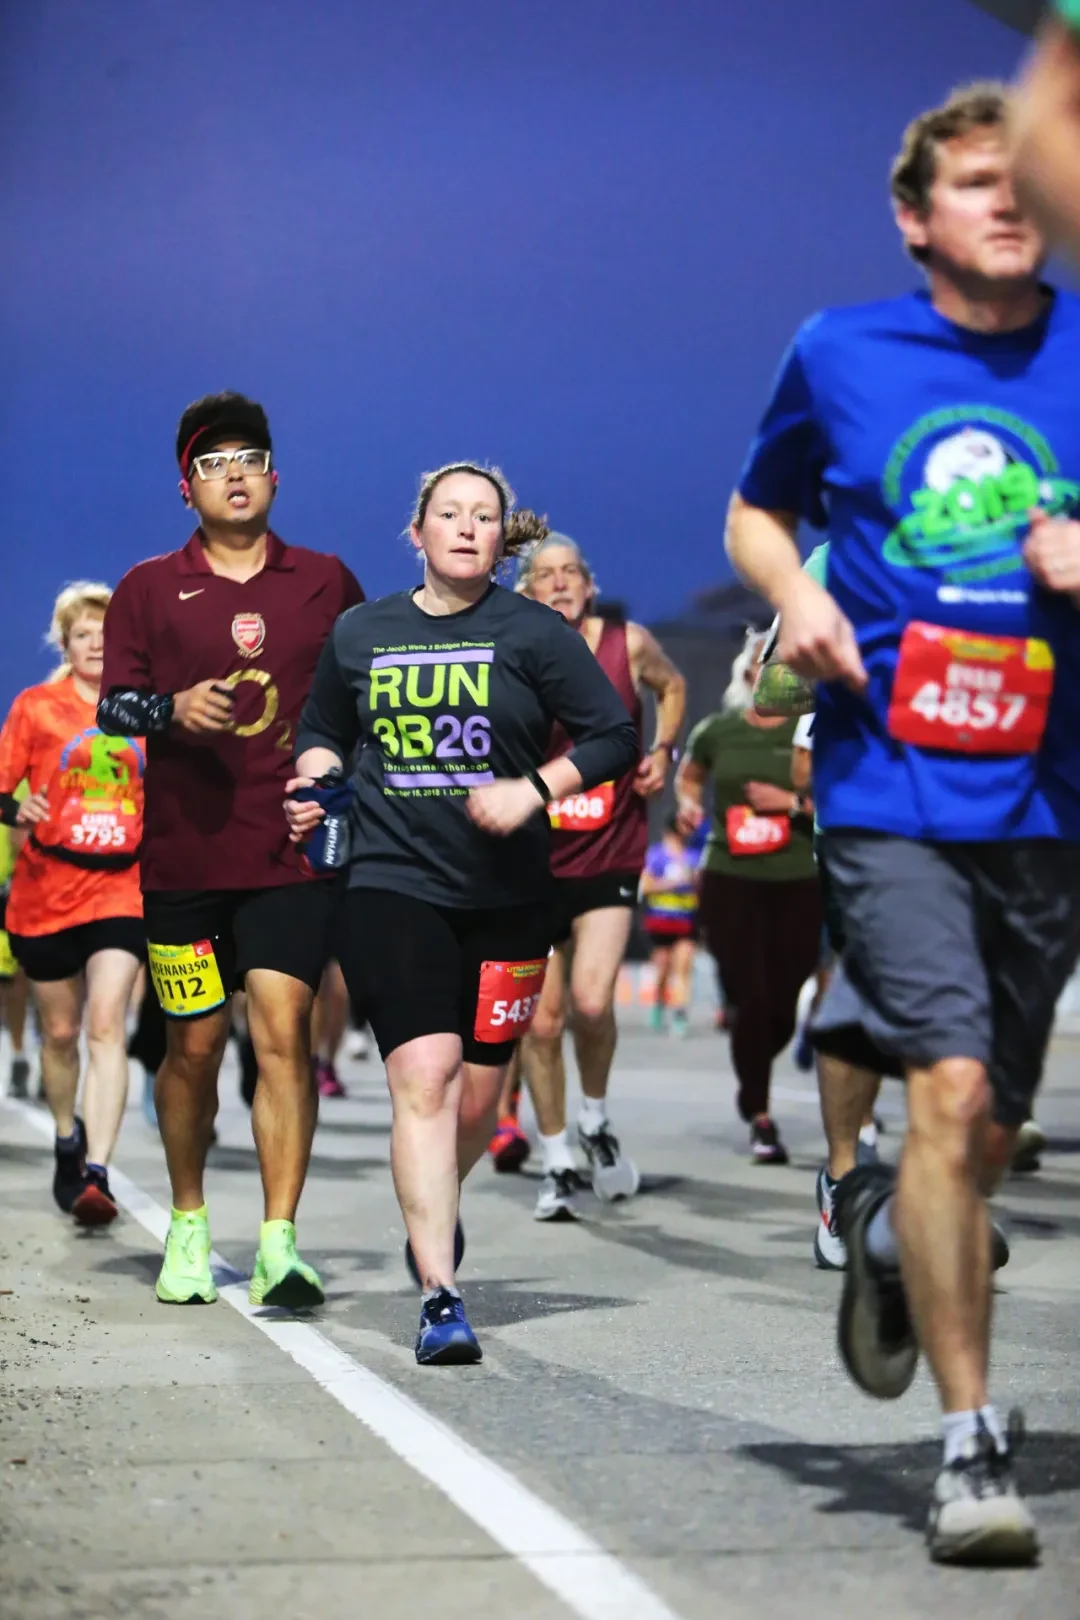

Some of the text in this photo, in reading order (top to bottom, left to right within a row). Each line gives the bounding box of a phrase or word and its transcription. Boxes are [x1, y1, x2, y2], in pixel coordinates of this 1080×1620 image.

[373, 647, 386, 655] The
[386, 645, 408, 653] Jacob
[434, 642, 461, 651] Bridges
[369, 663, 490, 711] RUN
[909, 680, 1027, 732] 4857
[373, 714, 491, 758] 3B26
[383, 762, 490, 772] briesmathan.com
[70, 824, 126, 847] 3795
[325, 818, 339, 865] NATHAN
[196, 946, 204, 956] C
